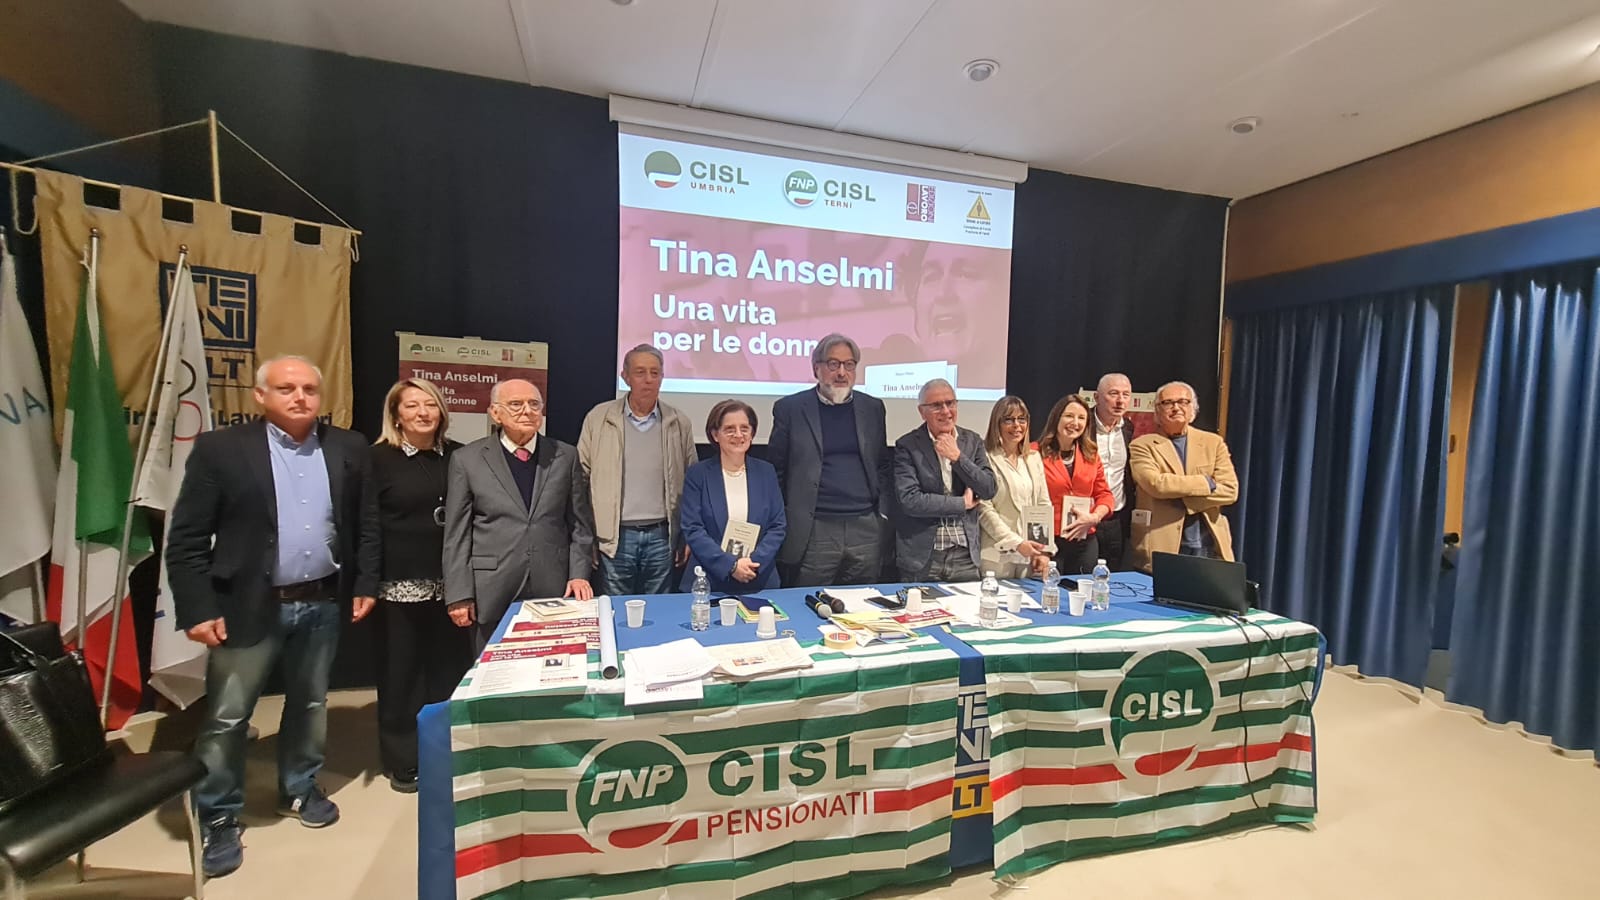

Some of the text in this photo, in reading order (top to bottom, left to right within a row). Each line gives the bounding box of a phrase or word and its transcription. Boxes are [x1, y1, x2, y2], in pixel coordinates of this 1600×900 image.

[689, 161, 749, 185] CISL
[789, 176, 815, 191] FNP
[690, 182, 736, 195] UMBRIA
[823, 179, 876, 202] CISL
[824, 199, 853, 209] TERNI
[921, 185, 929, 222] LAVORO
[650, 239, 894, 290] Tina Anselmi
[653, 293, 777, 325] Una vita
[425, 345, 446, 353] CISL
[471, 348, 491, 356] CISL
[653, 329, 819, 357] per le donn
[203, 356, 246, 379] LT
[412, 368, 498, 384] Tina Anselmi
[440, 386, 455, 395] ita
[445, 396, 477, 406] donne
[1121, 688, 1203, 722] CISL
[708, 736, 867, 797] CISL
[589, 764, 674, 806] FNP
[952, 783, 989, 811] LT
[707, 791, 868, 838] PENSIONATI
